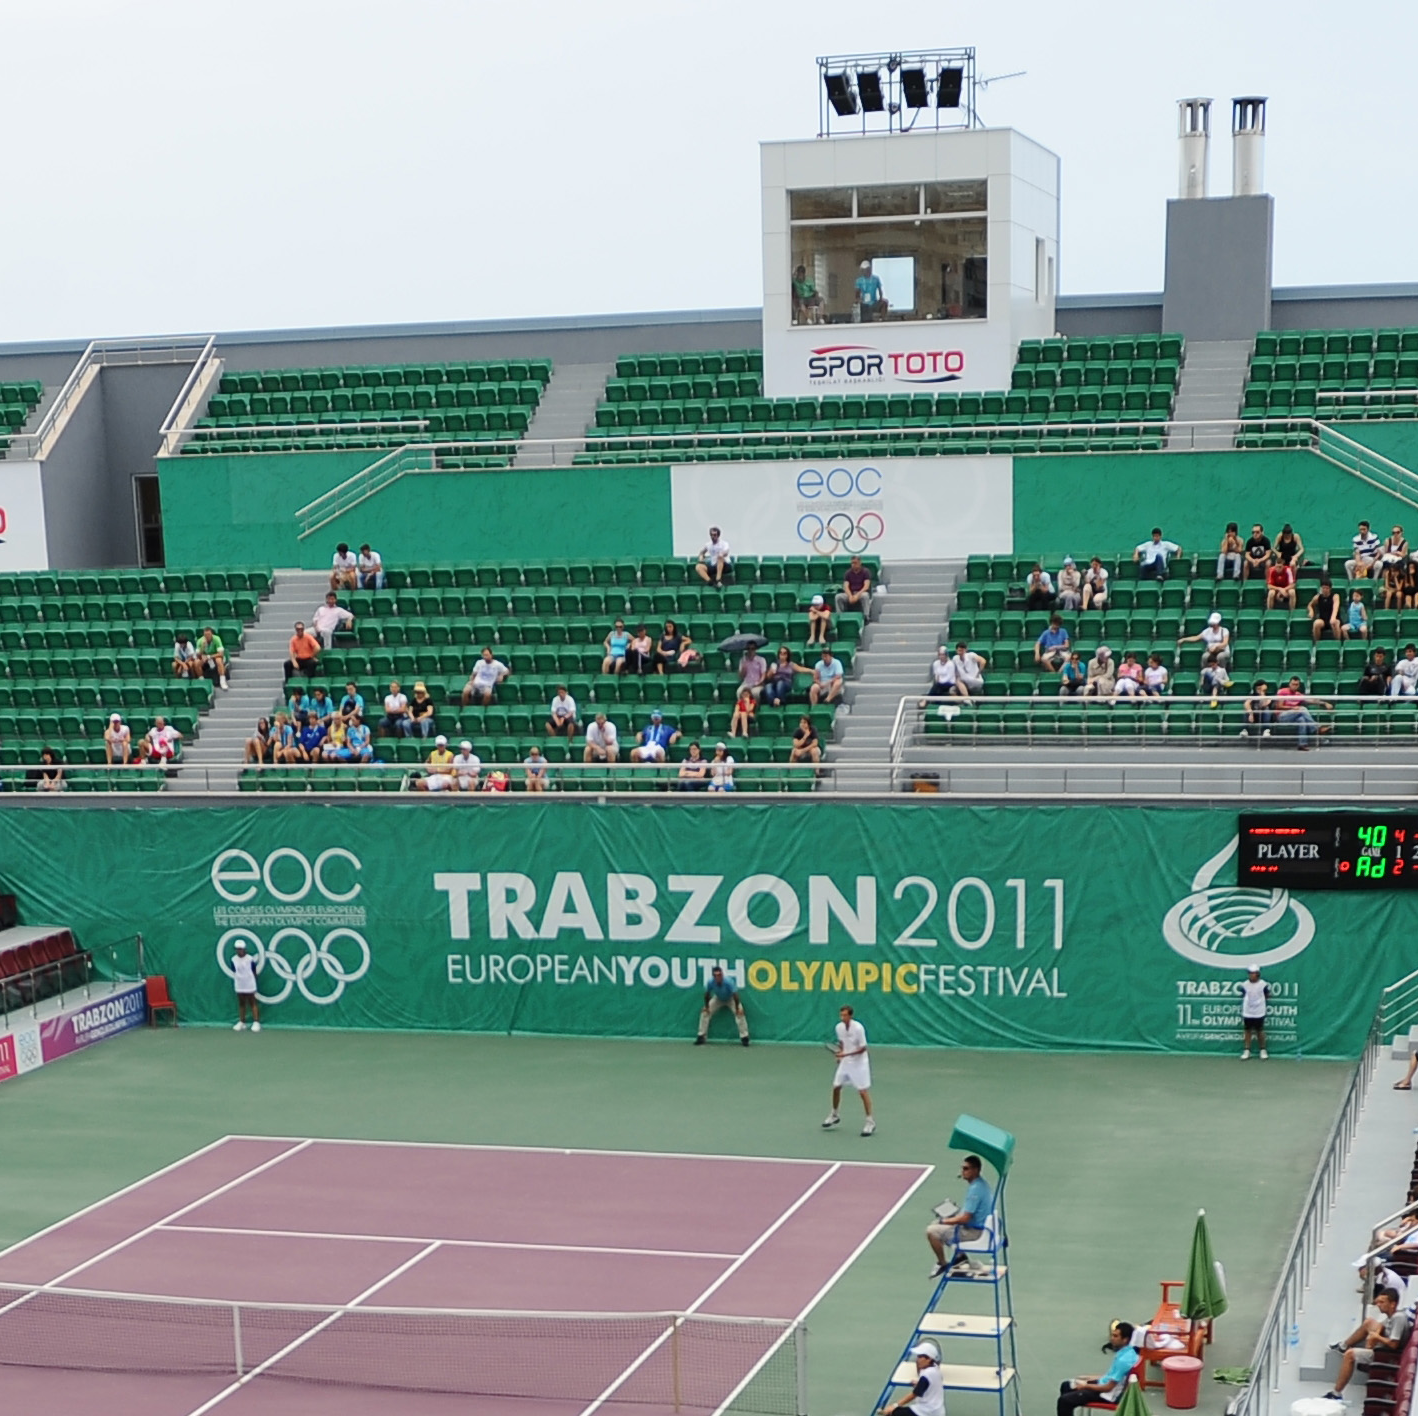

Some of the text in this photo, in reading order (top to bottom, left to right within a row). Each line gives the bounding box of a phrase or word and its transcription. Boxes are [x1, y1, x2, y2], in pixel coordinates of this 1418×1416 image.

[809, 351, 964, 378] SPOR TOTO
[1358, 826, 1387, 846] 40
[1394, 829, 1406, 843] 4
[1257, 844, 1320, 859] PLAYER
[1396, 845, 1401, 858] 1
[211, 847, 362, 902] eoc
[1356, 856, 1386, 878] Ad
[1393, 859, 1405, 875] 2
